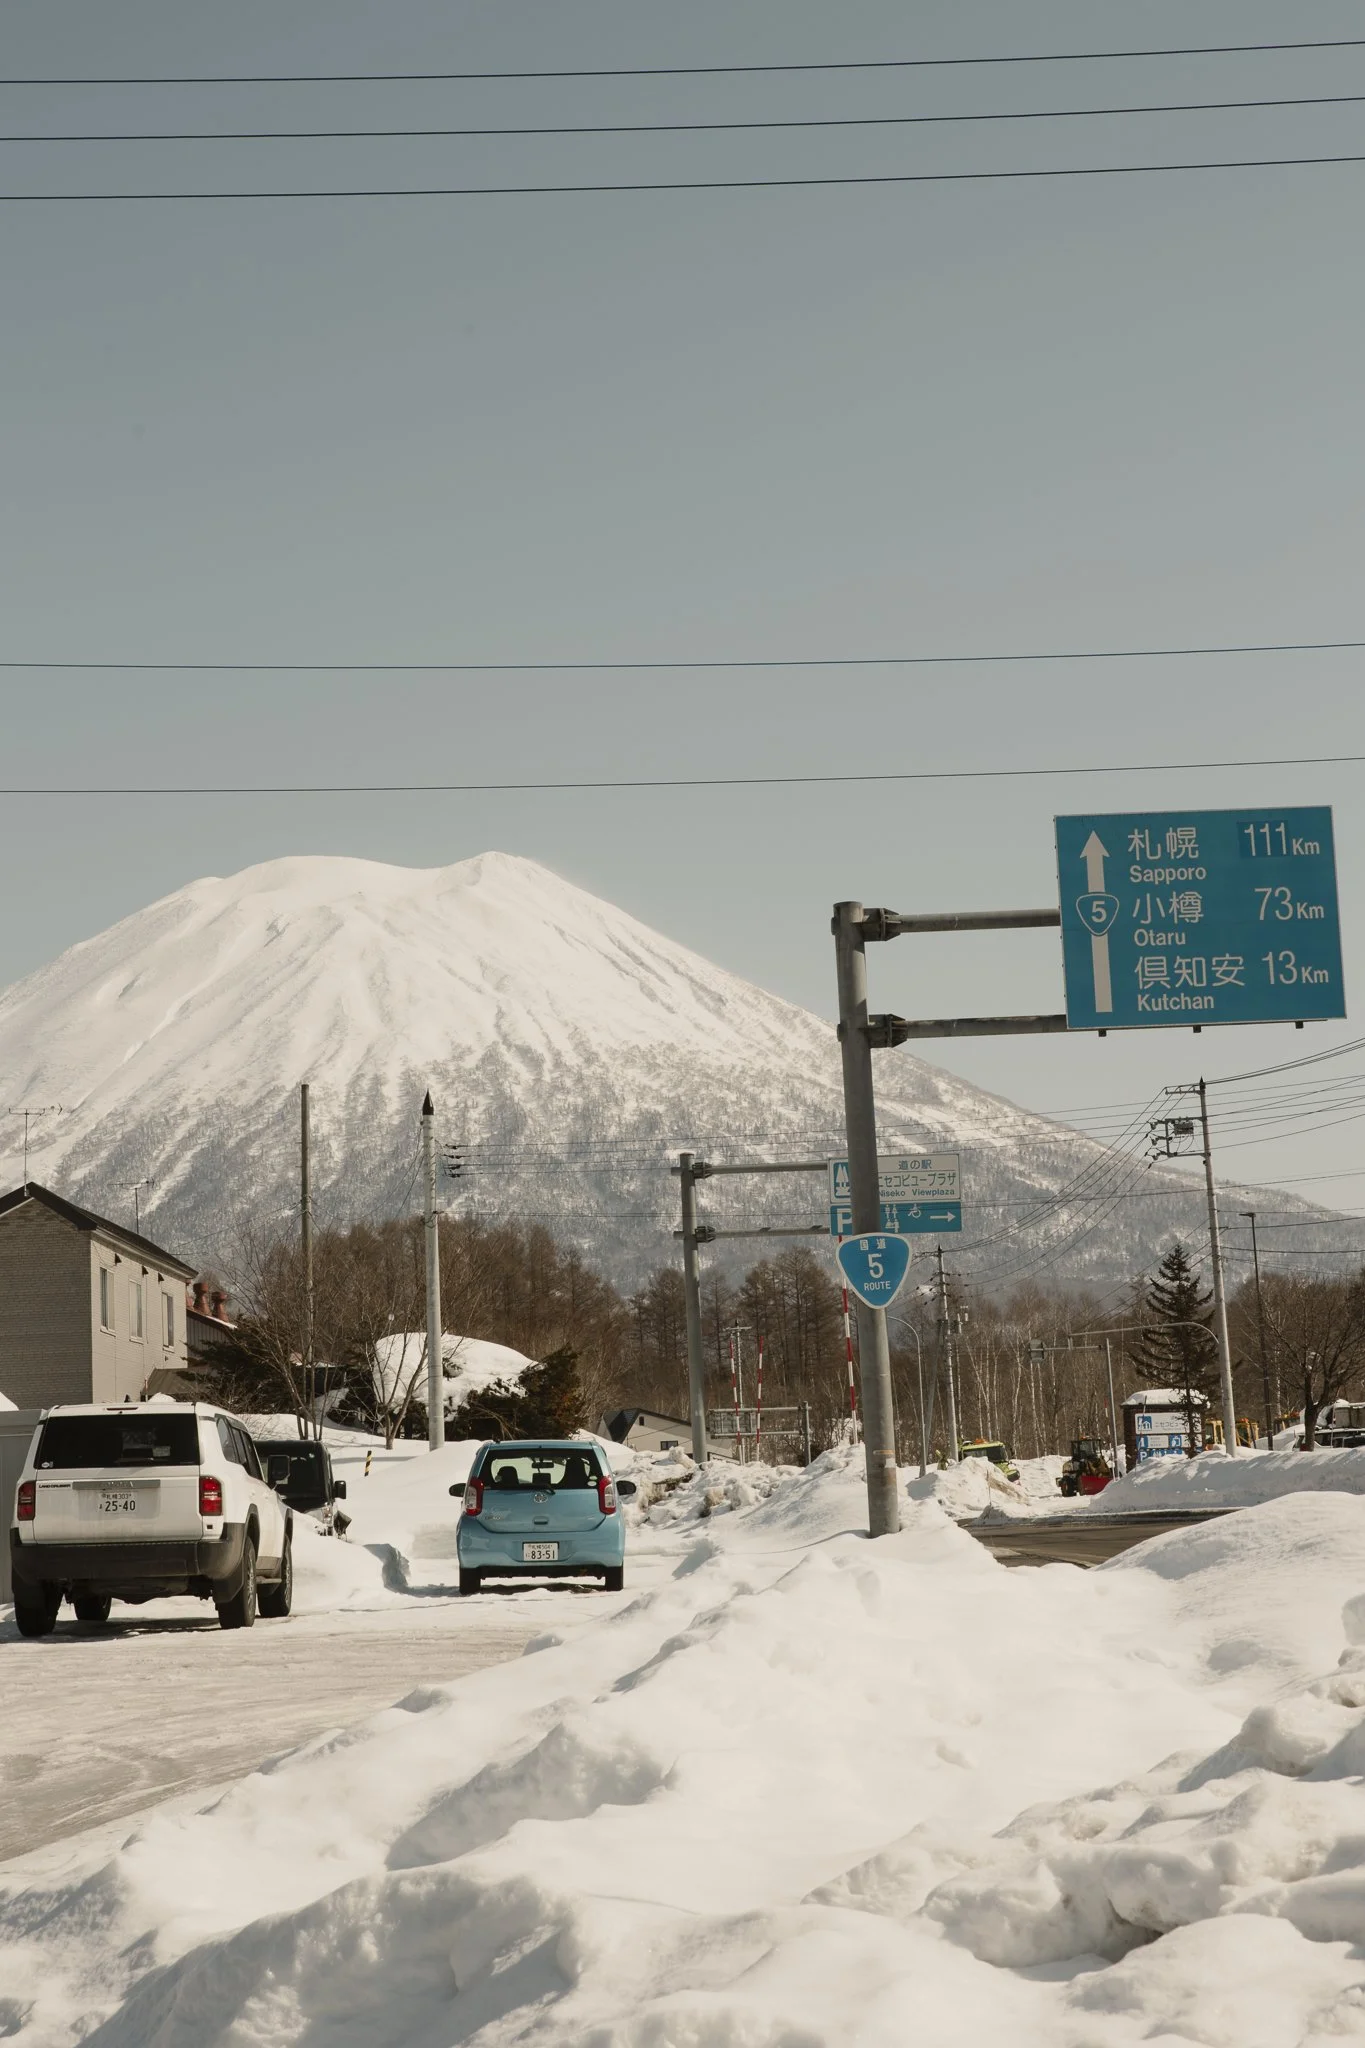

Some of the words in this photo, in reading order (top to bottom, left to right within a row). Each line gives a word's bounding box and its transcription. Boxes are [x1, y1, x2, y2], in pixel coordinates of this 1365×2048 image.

[1128, 827, 1200, 861] 札幌
[1129, 864, 1207, 885] Sapporo
[1091, 900, 1107, 923] 5
[1132, 891, 1204, 925] 小樽
[1133, 929, 1187, 947] Otaru
[1134, 953, 1246, 990] 倶知安
[1137, 993, 1215, 1012] Kutchan
[898, 1159, 932, 1171] 道の駅
[911, 1187, 955, 1198] Viewplaza
[867, 1253, 884, 1279] 5
[863, 1280, 891, 1291] ROUTE
